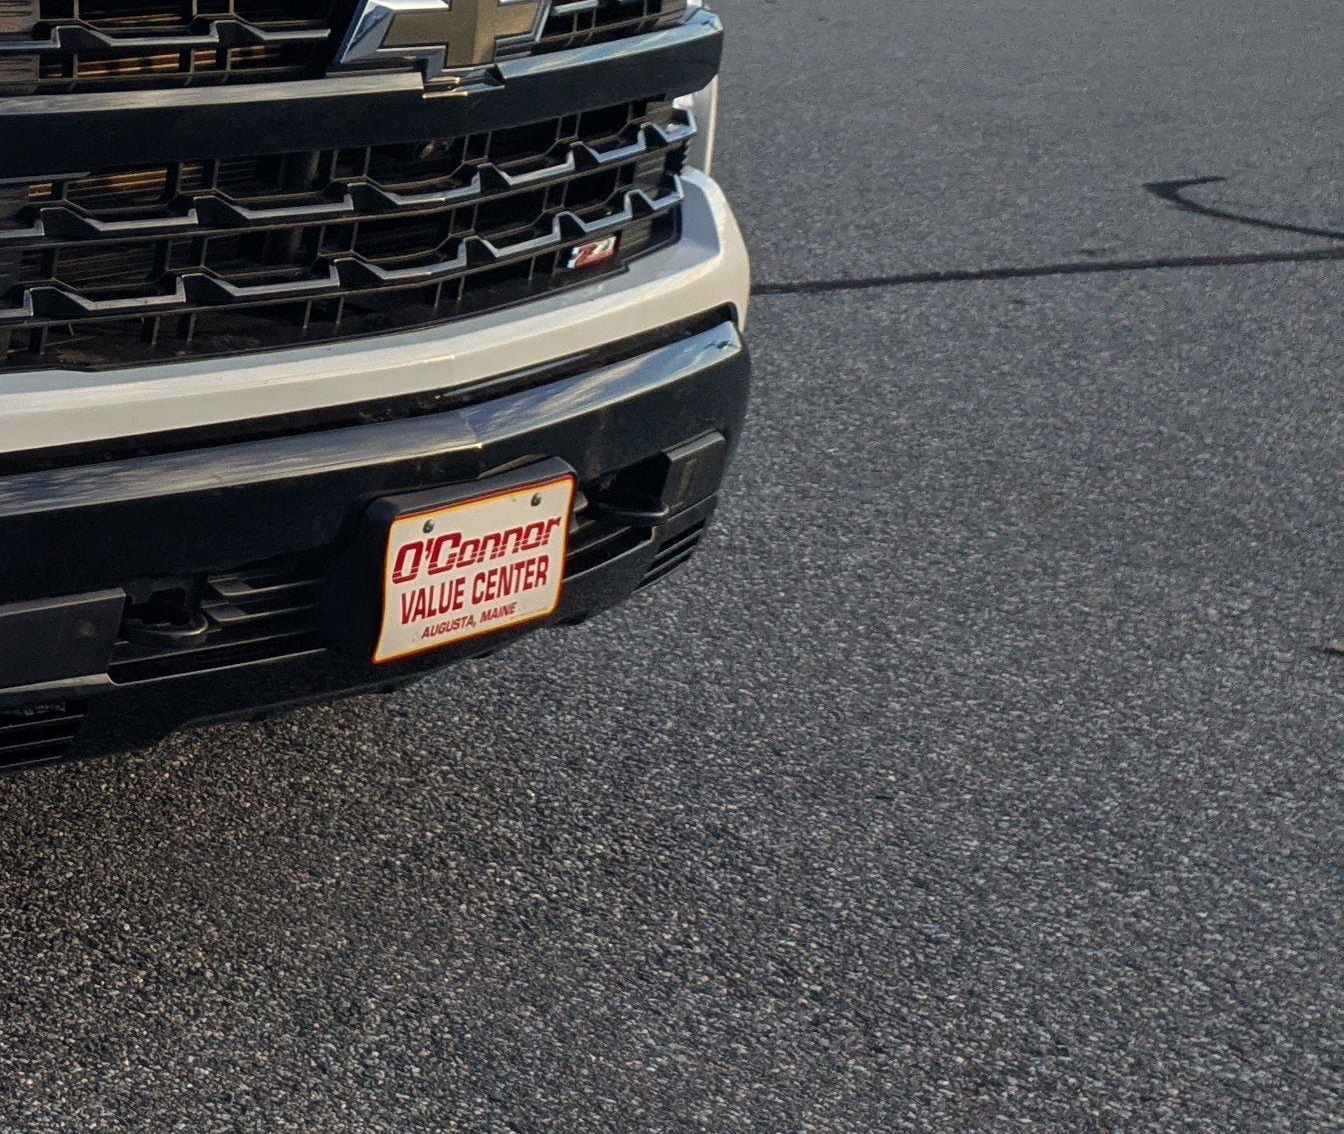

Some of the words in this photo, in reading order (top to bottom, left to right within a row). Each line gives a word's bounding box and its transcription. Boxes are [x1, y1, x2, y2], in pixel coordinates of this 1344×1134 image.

[391, 516, 562, 585] O'Connor
[401, 576, 466, 625] VALUE
[471, 554, 549, 605] CENTER
[421, 614, 477, 639] AUGUSTA,
[480, 602, 517, 624] MAINE
